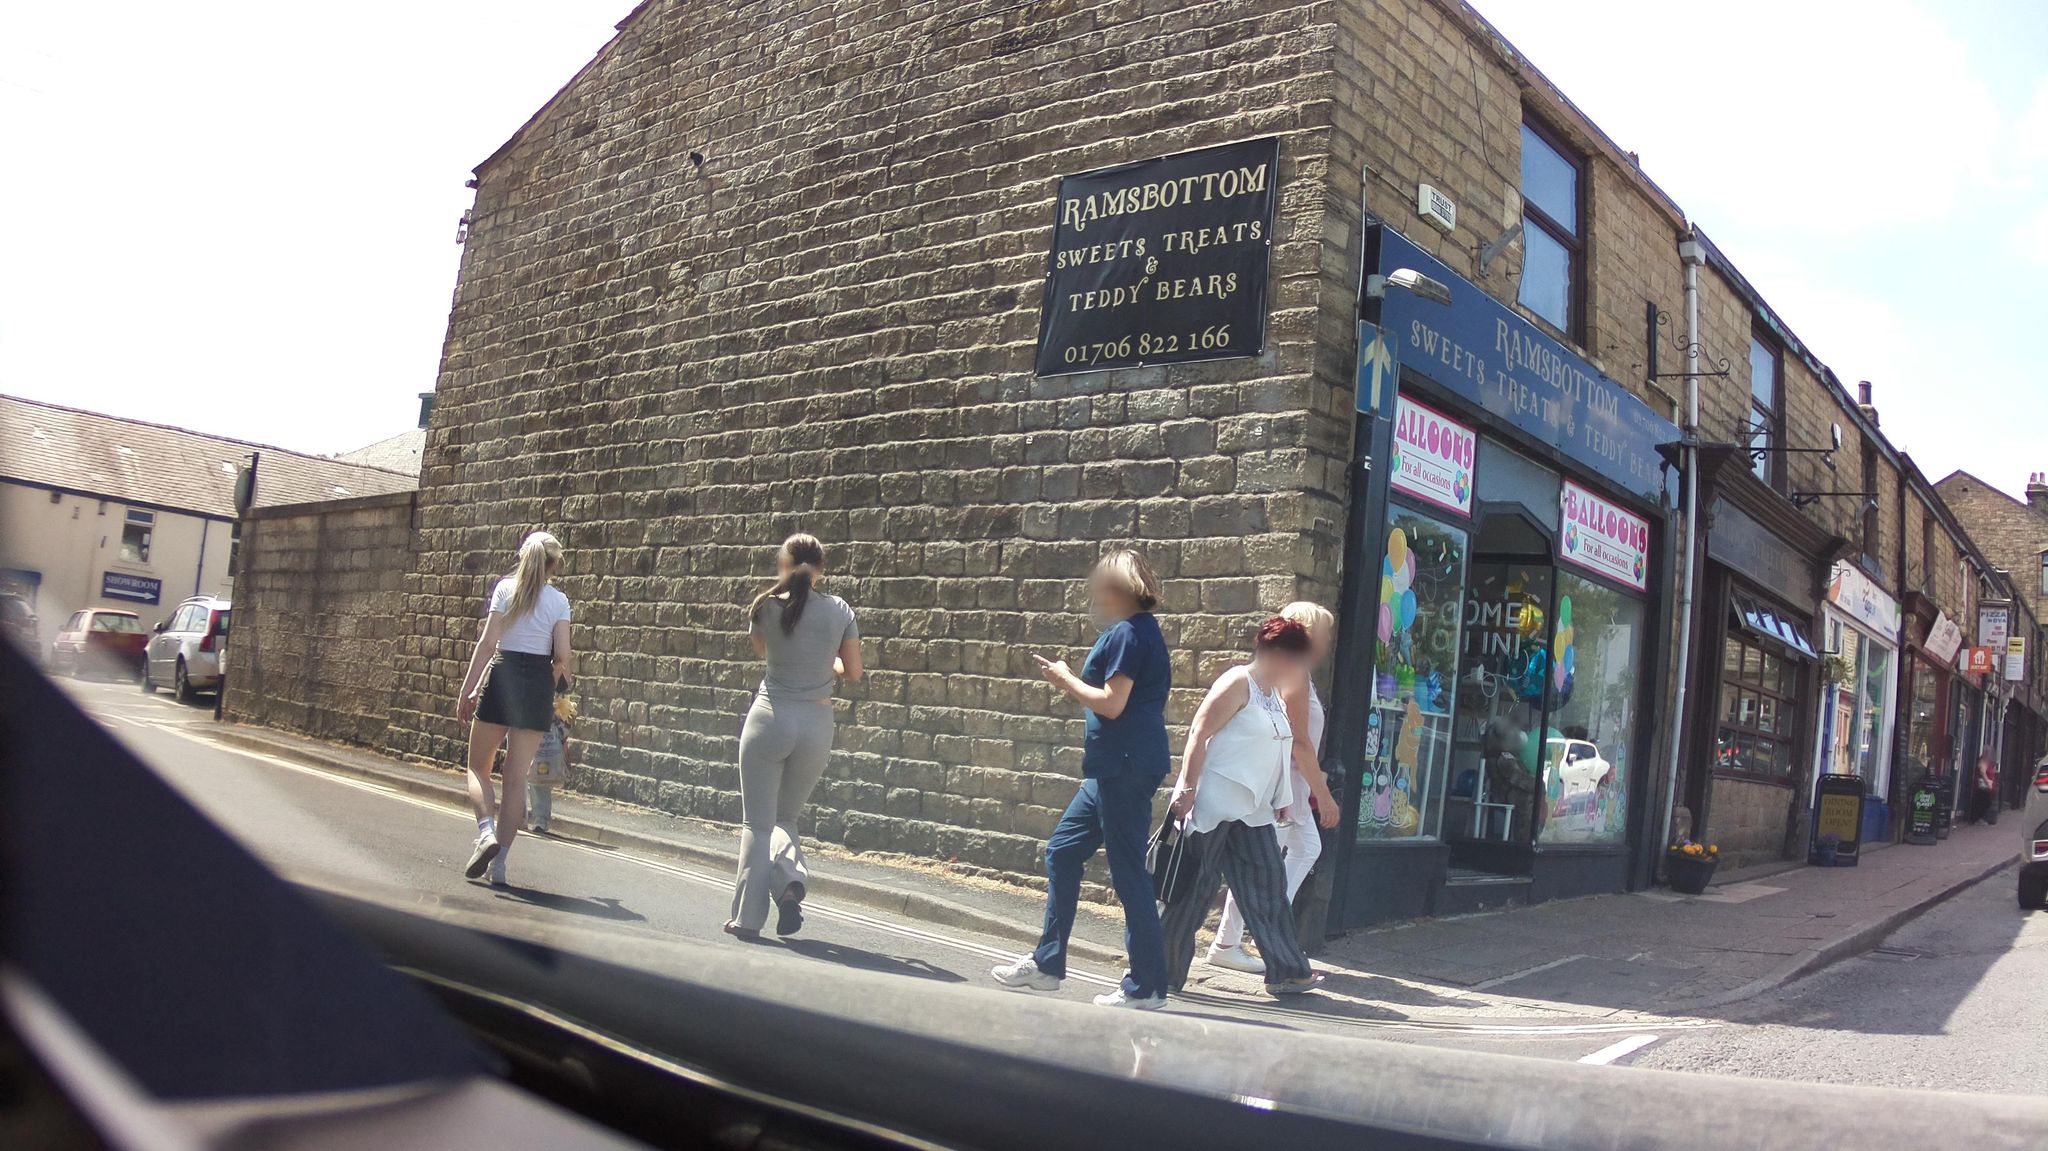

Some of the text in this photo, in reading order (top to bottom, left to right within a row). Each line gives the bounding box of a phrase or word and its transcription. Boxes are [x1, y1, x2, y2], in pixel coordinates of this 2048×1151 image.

[1061, 163, 1268, 231] RAMSBOTTOM
[1431, 191, 1452, 211] TRUST
[1057, 221, 1261, 270] SWEETS TREATS
[1146, 256, 1158, 275] &
[1069, 273, 1238, 313] TEDDY BEARS
[1064, 324, 1231, 366] 01706 822 166
[1411, 320, 1485, 385] SWEETS
[1496, 370, 1559, 429] TREATS
[1566, 413, 1576, 438] &
[1585, 423, 1627, 466] TEDDY
[1496, 317, 1618, 427] RAMSBOTTOM
[1395, 407, 1473, 470] ALLOONS
[1401, 455, 1451, 491] For all occasions
[1567, 489, 1647, 555] BALLOONS
[1583, 538, 1594, 555] For
[1602, 550, 1629, 571] occasions
[105, 575, 158, 590] SHOWROOM
